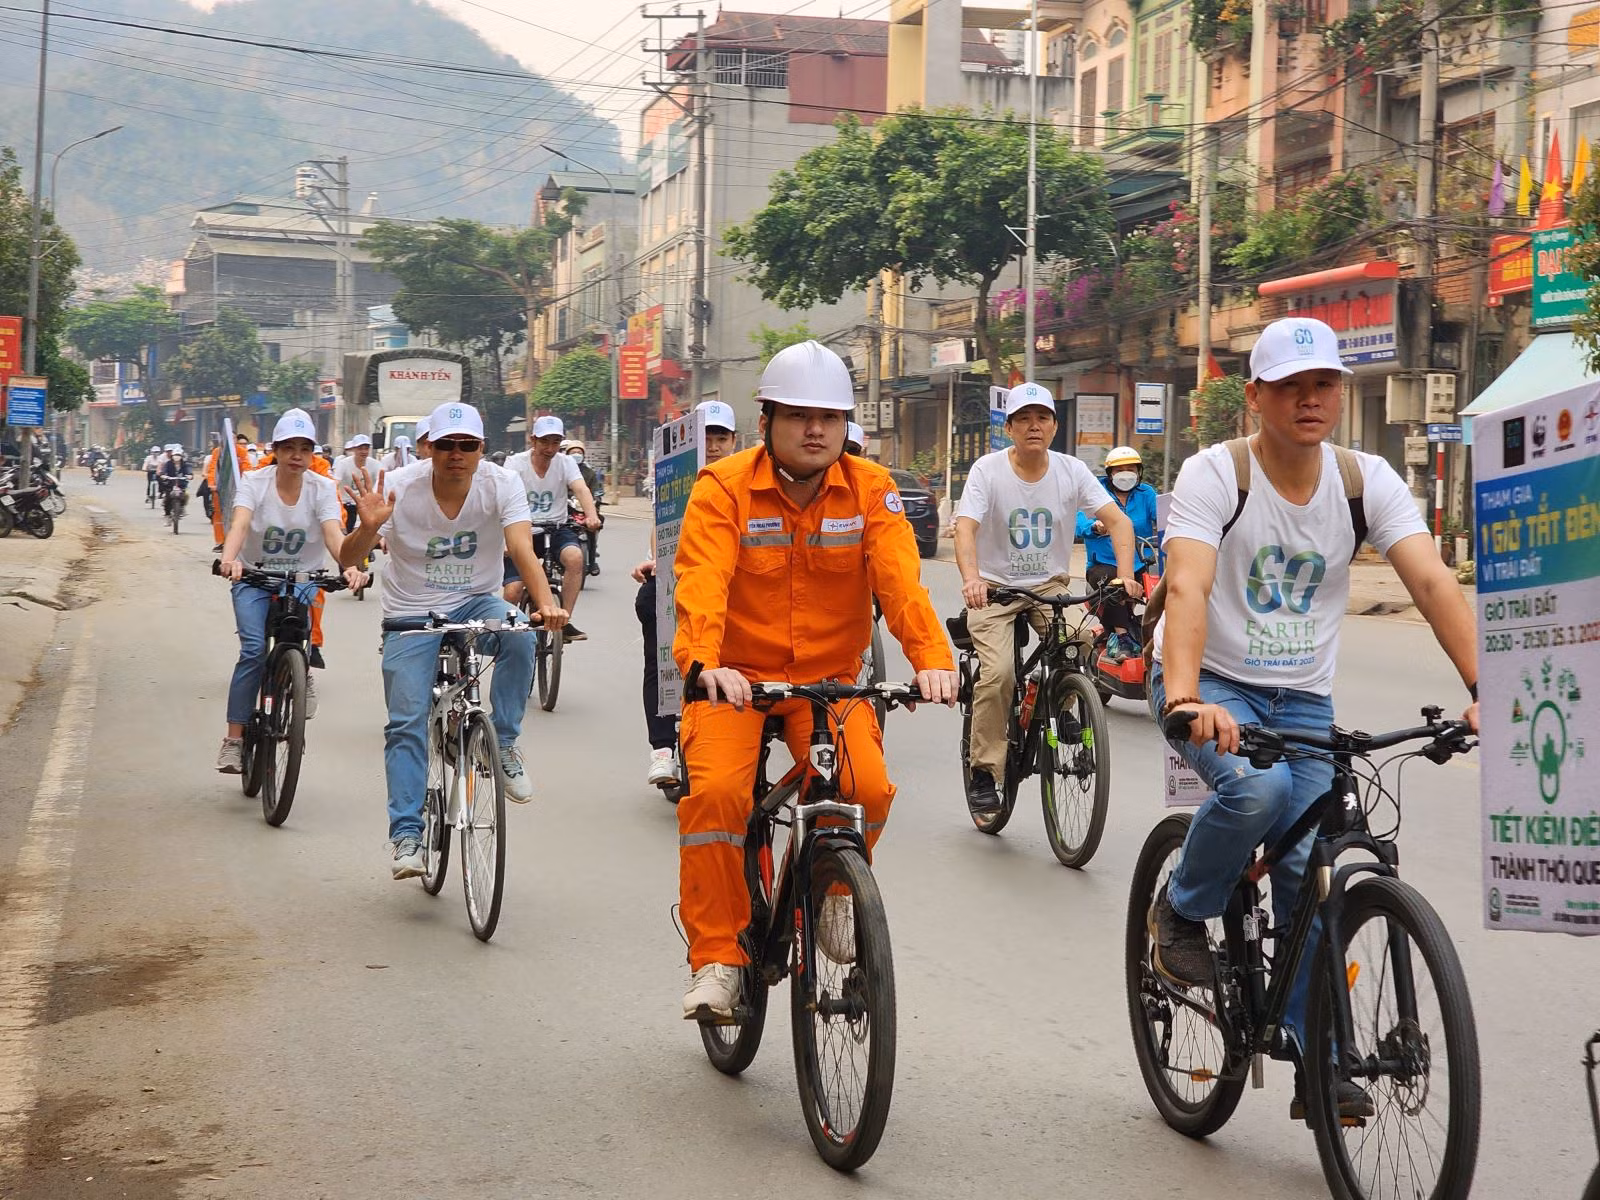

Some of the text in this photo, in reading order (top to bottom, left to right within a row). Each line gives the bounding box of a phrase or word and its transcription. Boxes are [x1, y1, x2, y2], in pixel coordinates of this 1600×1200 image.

[1294, 328, 1314, 345] 60
[449, 408, 463, 419] 60
[1481, 484, 1533, 511] THAM GIA
[1009, 508, 1053, 550] 60
[1491, 509, 1523, 554] GIỜ
[1525, 491, 1562, 549] TẮT
[262, 525, 306, 555] 60
[425, 530, 477, 560] 60
[425, 562, 474, 575] EARTH
[1247, 544, 1327, 615] 60
[1481, 550, 1542, 582] VÌ TRÁI ĐẤT
[1484, 588, 1558, 622] GIỜ TRÁI ĐẤT
[1245, 619, 1316, 639] EARTH
[1485, 632, 1513, 653] 20:30
[1244, 656, 1261, 667] GIỜ
[1263, 657, 1281, 667] TRÁI
[1282, 657, 1298, 667] ĐẤT
[1247, 639, 1315, 657] HOUR
[1525, 809, 1567, 849] KIỆM
[1490, 851, 1537, 882] THÀNH
